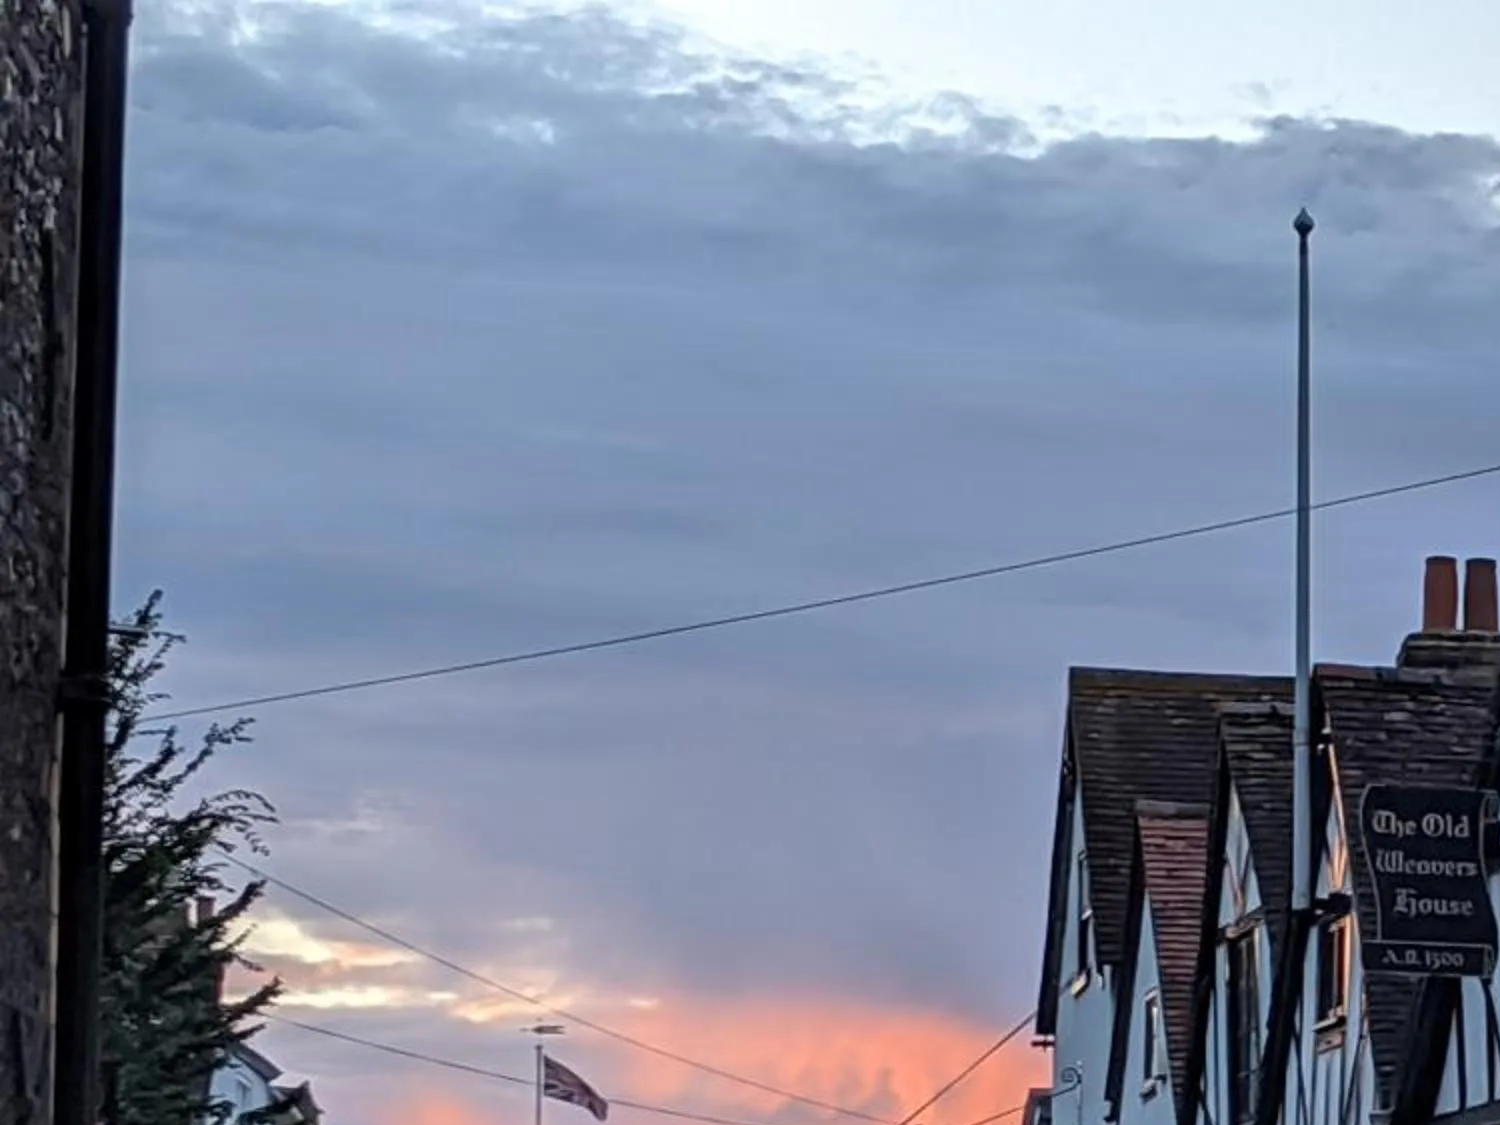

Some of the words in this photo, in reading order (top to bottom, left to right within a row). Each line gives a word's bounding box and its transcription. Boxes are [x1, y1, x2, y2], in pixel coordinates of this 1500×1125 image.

[1372, 810, 1417, 838] The
[1421, 812, 1470, 838] Old
[1375, 850, 1480, 876] Weavers
[1392, 887, 1474, 917] House
